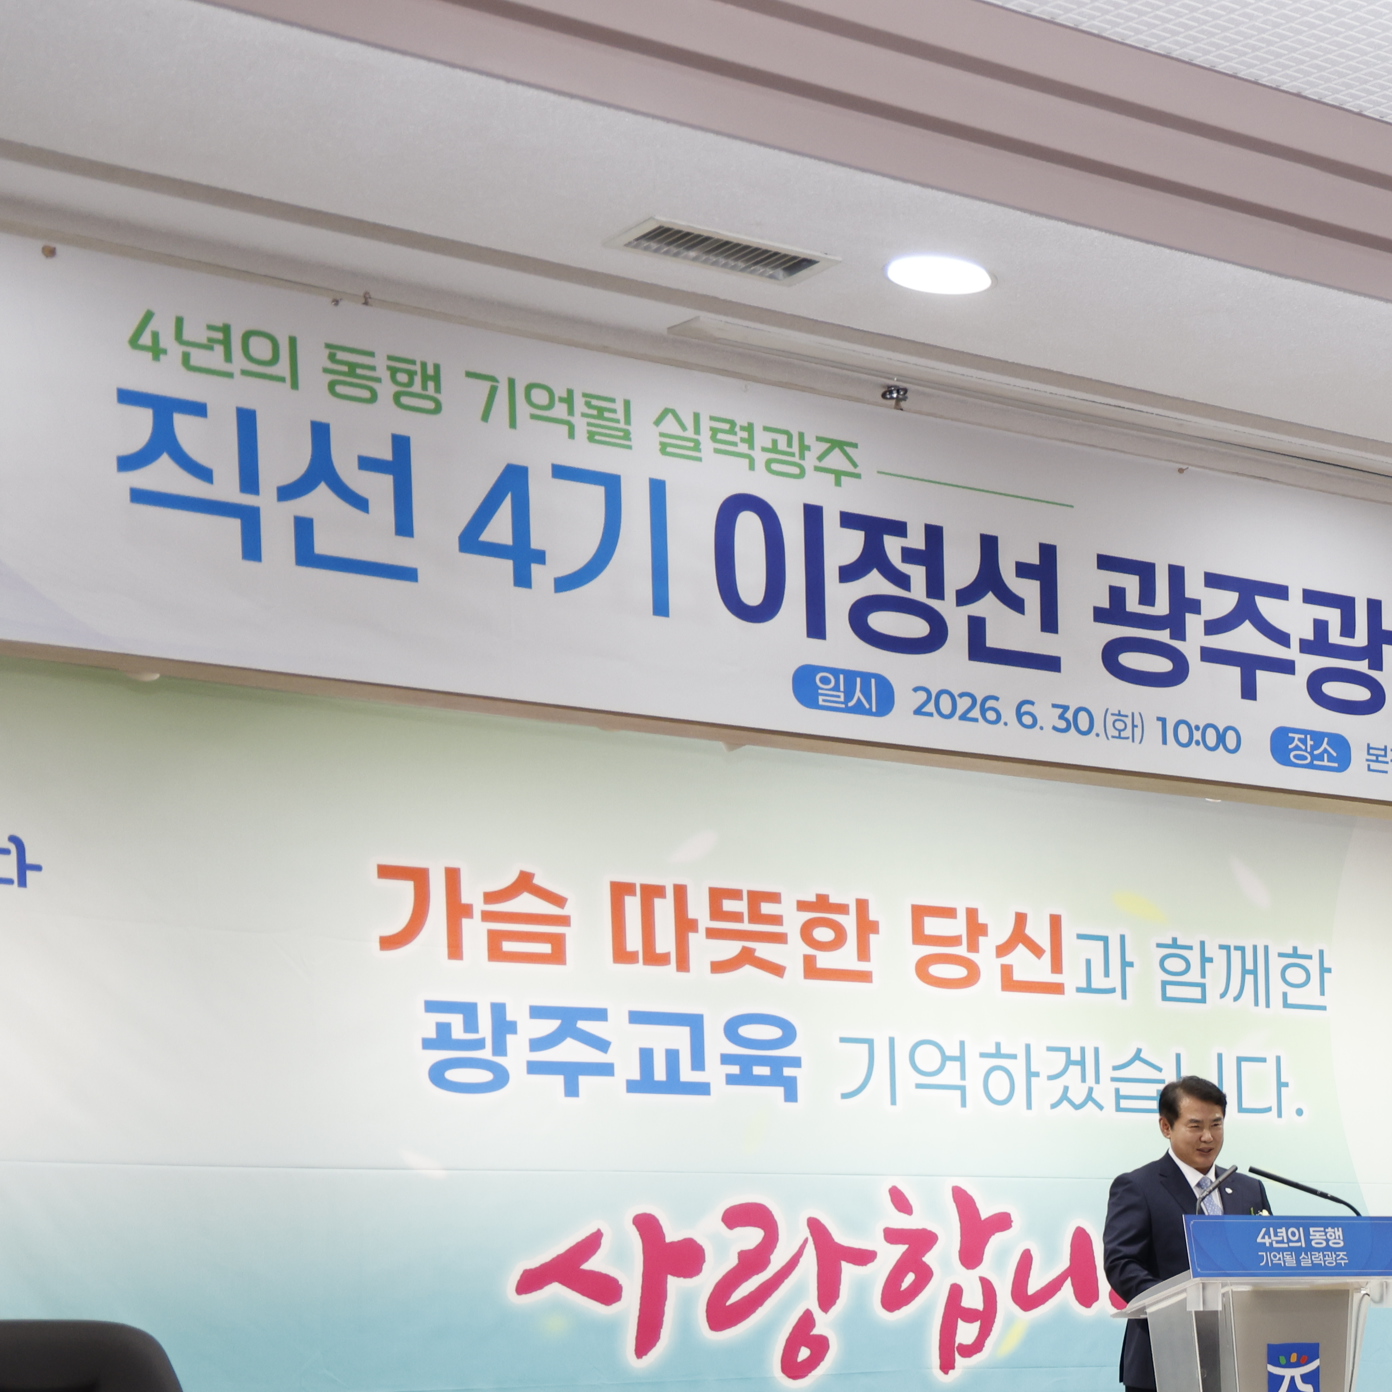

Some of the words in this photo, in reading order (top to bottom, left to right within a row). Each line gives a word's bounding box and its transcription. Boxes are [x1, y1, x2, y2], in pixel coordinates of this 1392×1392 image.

[127, 309, 302, 391] 4년의
[321, 342, 444, 416] 동행
[465, 370, 634, 452] 기억될
[653, 406, 862, 486] 실력광주
[115, 386, 419, 584] 직선
[457, 462, 671, 618] 4기
[712, 492, 1063, 674] 이정선
[815, 672, 877, 713] 일시
[912, 685, 1008, 727] 2026.
[1014, 699, 1044, 731] 6.
[1156, 716, 1242, 754] 10:00
[1287, 732, 1339, 768] 장소
[375, 862, 573, 967] 가슴
[608, 879, 882, 984] 따뜻한
[910, 904, 1135, 1003] 당신과
[1155, 934, 1332, 1014] 함께한
[420, 997, 804, 1103] 광주교육
[516, 1185, 1127, 1380] 사랑합니
[1257, 1227, 1306, 1248] 4년의
[1309, 1227, 1344, 1248] 동행
[1258, 1252, 1296, 1267] 기억될
[1300, 1251, 1349, 1267] 실력광주
